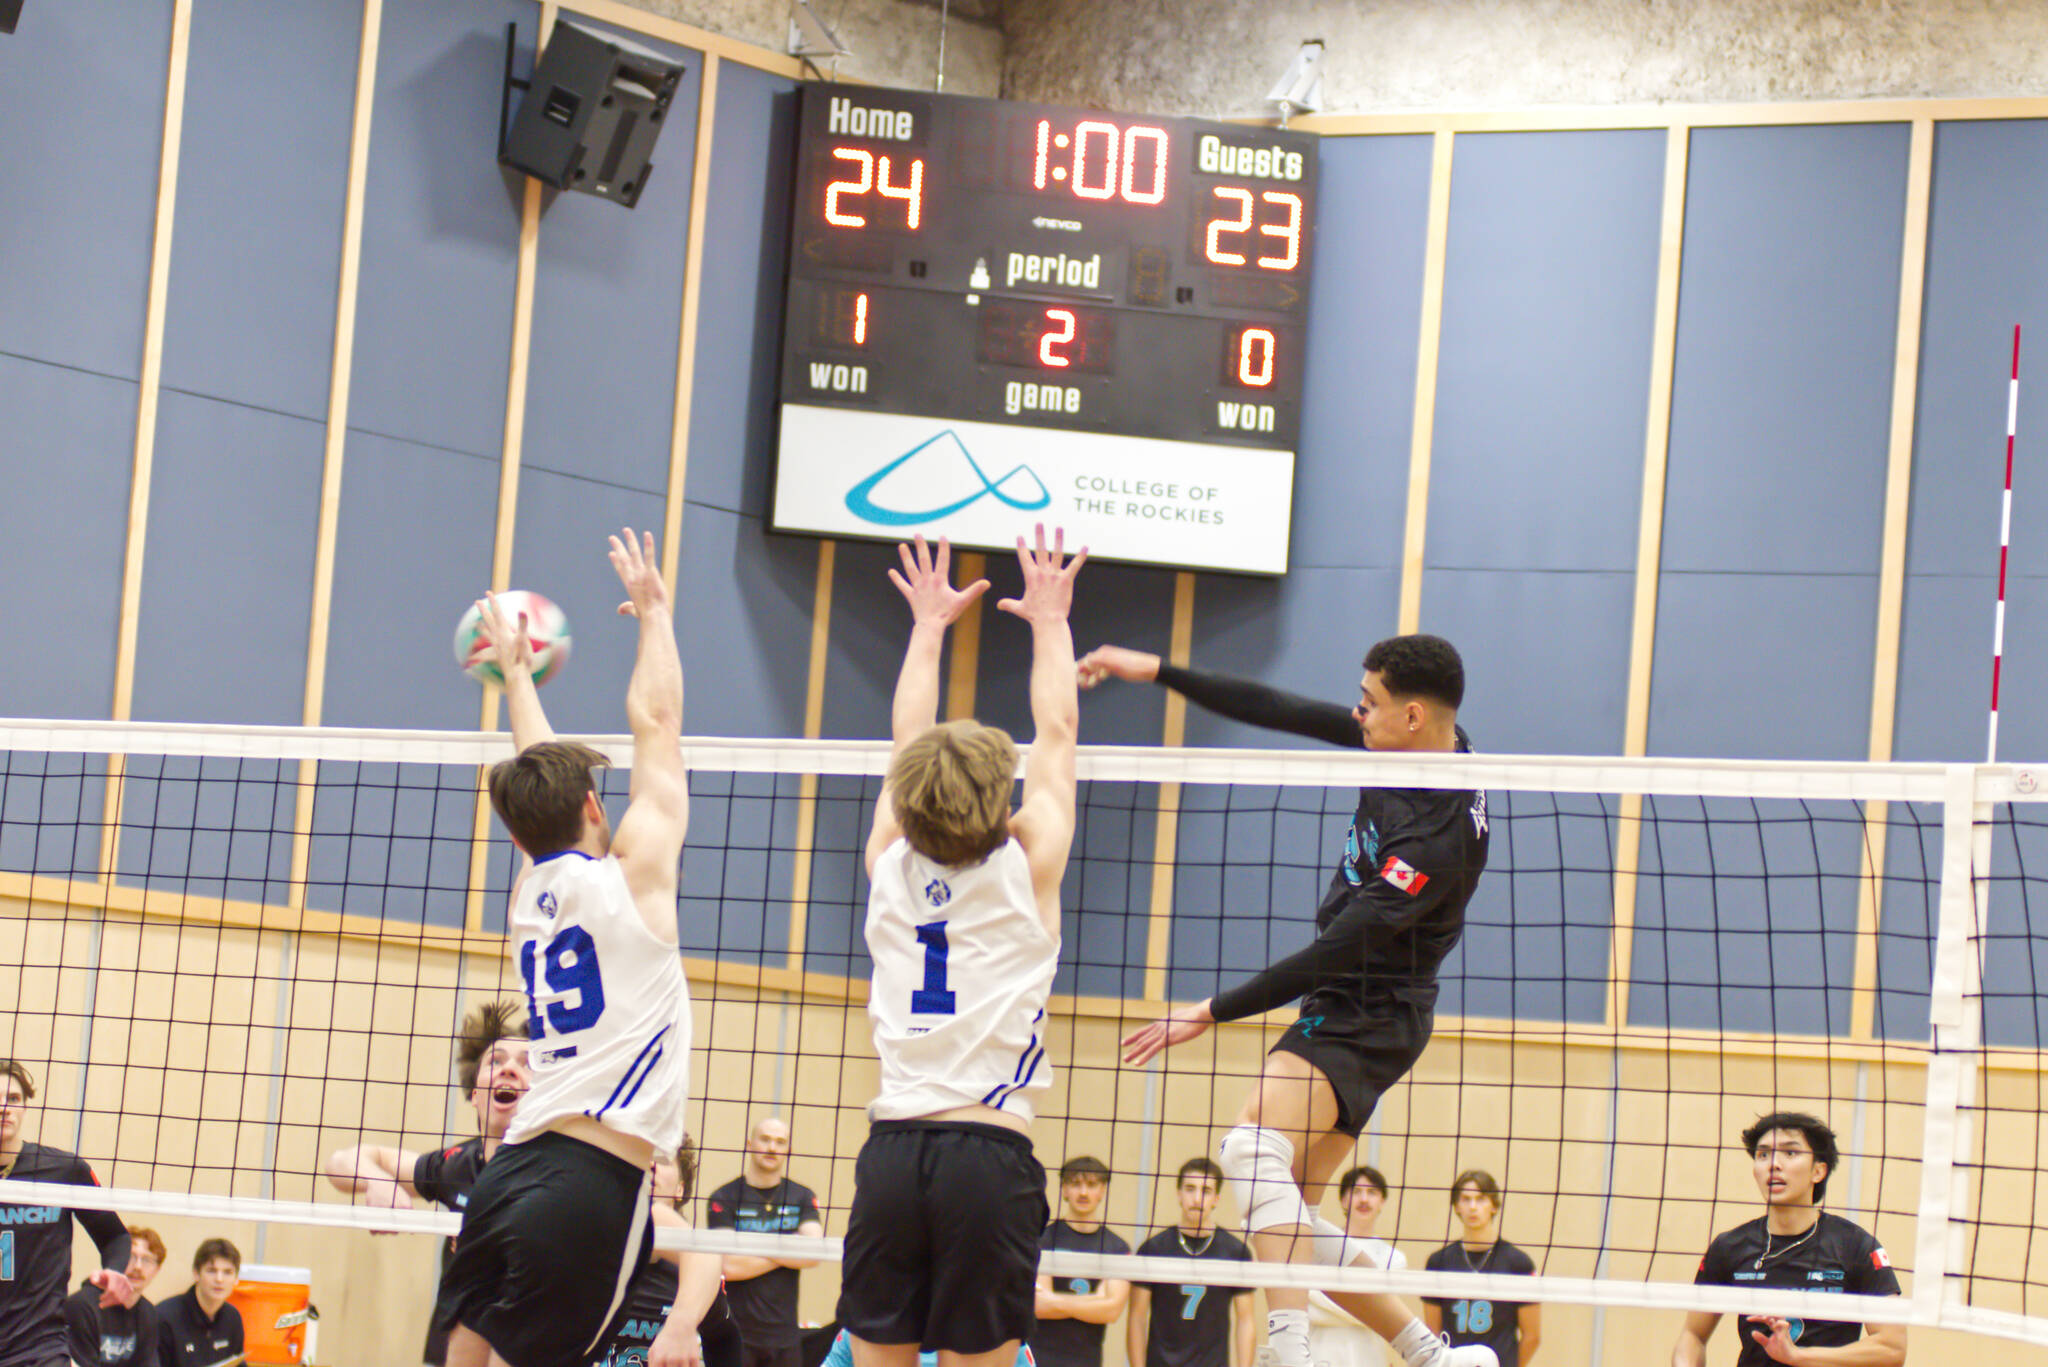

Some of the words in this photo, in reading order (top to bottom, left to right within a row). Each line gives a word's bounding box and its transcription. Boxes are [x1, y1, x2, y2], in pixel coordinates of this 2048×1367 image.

[829, 97, 913, 140] Home
[1033, 119, 1169, 204] 1:00
[1199, 135, 1303, 180] Guests
[825, 147, 924, 230] 24
[1204, 186, 1303, 270] 23
[1007, 251, 1101, 289] period
[853, 293, 870, 345] 1
[1039, 308, 1076, 367] 2
[810, 361, 868, 394] won
[1238, 328, 1276, 386] 0
[1006, 381, 1081, 415] game
[1217, 400, 1275, 433] won
[1074, 475, 1179, 499] COLLEGE
[1188, 486, 1219, 501] OF
[1074, 497, 1116, 515] THE
[1126, 502, 1224, 525] ROCKIES
[520, 924, 606, 1041] 19
[911, 920, 956, 1015] 1
[1181, 1284, 1207, 1320] 7
[1452, 1299, 1494, 1334] 18
